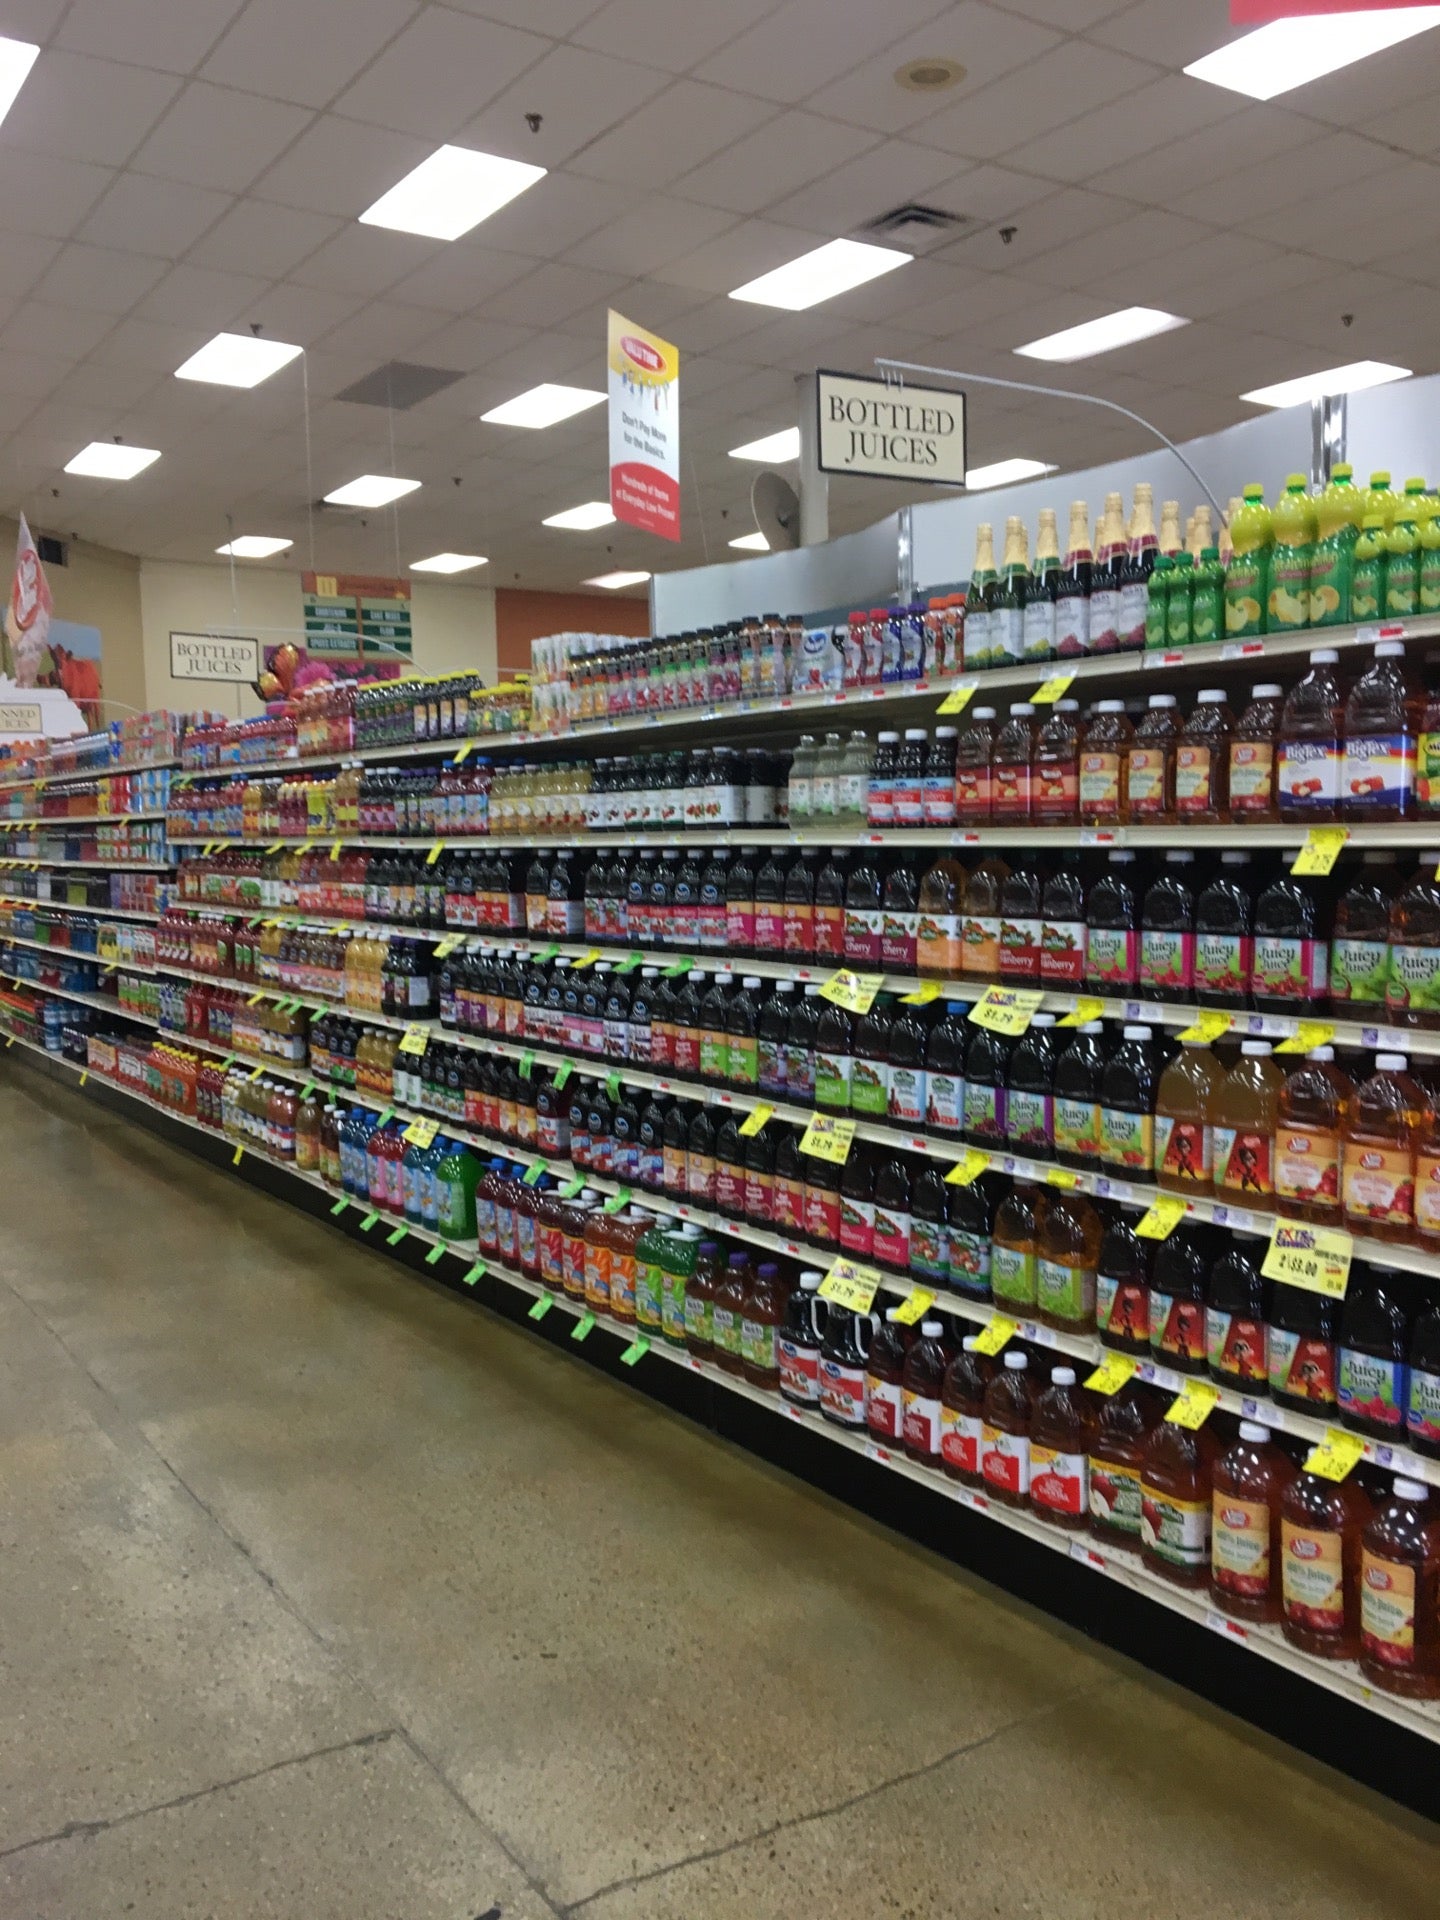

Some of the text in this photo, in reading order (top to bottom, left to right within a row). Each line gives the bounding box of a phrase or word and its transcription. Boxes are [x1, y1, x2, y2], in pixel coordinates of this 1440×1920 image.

[828, 395, 955, 437] BOTTLED
[622, 411, 667, 443] Don't Pay More
[624, 431, 633, 444] for
[633, 437, 643, 450] the
[844, 429, 938, 467] JUICES
[177, 643, 252, 661] BOTTLED
[186, 659, 242, 675] JUICES
[845, 940, 871, 954] cherry
[882, 944, 909, 958] cherry
[1092, 937, 1121, 952] Juicy
[1145, 940, 1177, 955] Juicy
[1200, 943, 1234, 959] Juicy
[1258, 946, 1296, 964] Juicy
[1339, 949, 1381, 966] Juicy
[1012, 1099, 1040, 1115] Juicy
[1060, 1107, 1090, 1122] Juicy
[1104, 1117, 1137, 1133] Juicy
[1343, 1359, 1387, 1384] Juicy
